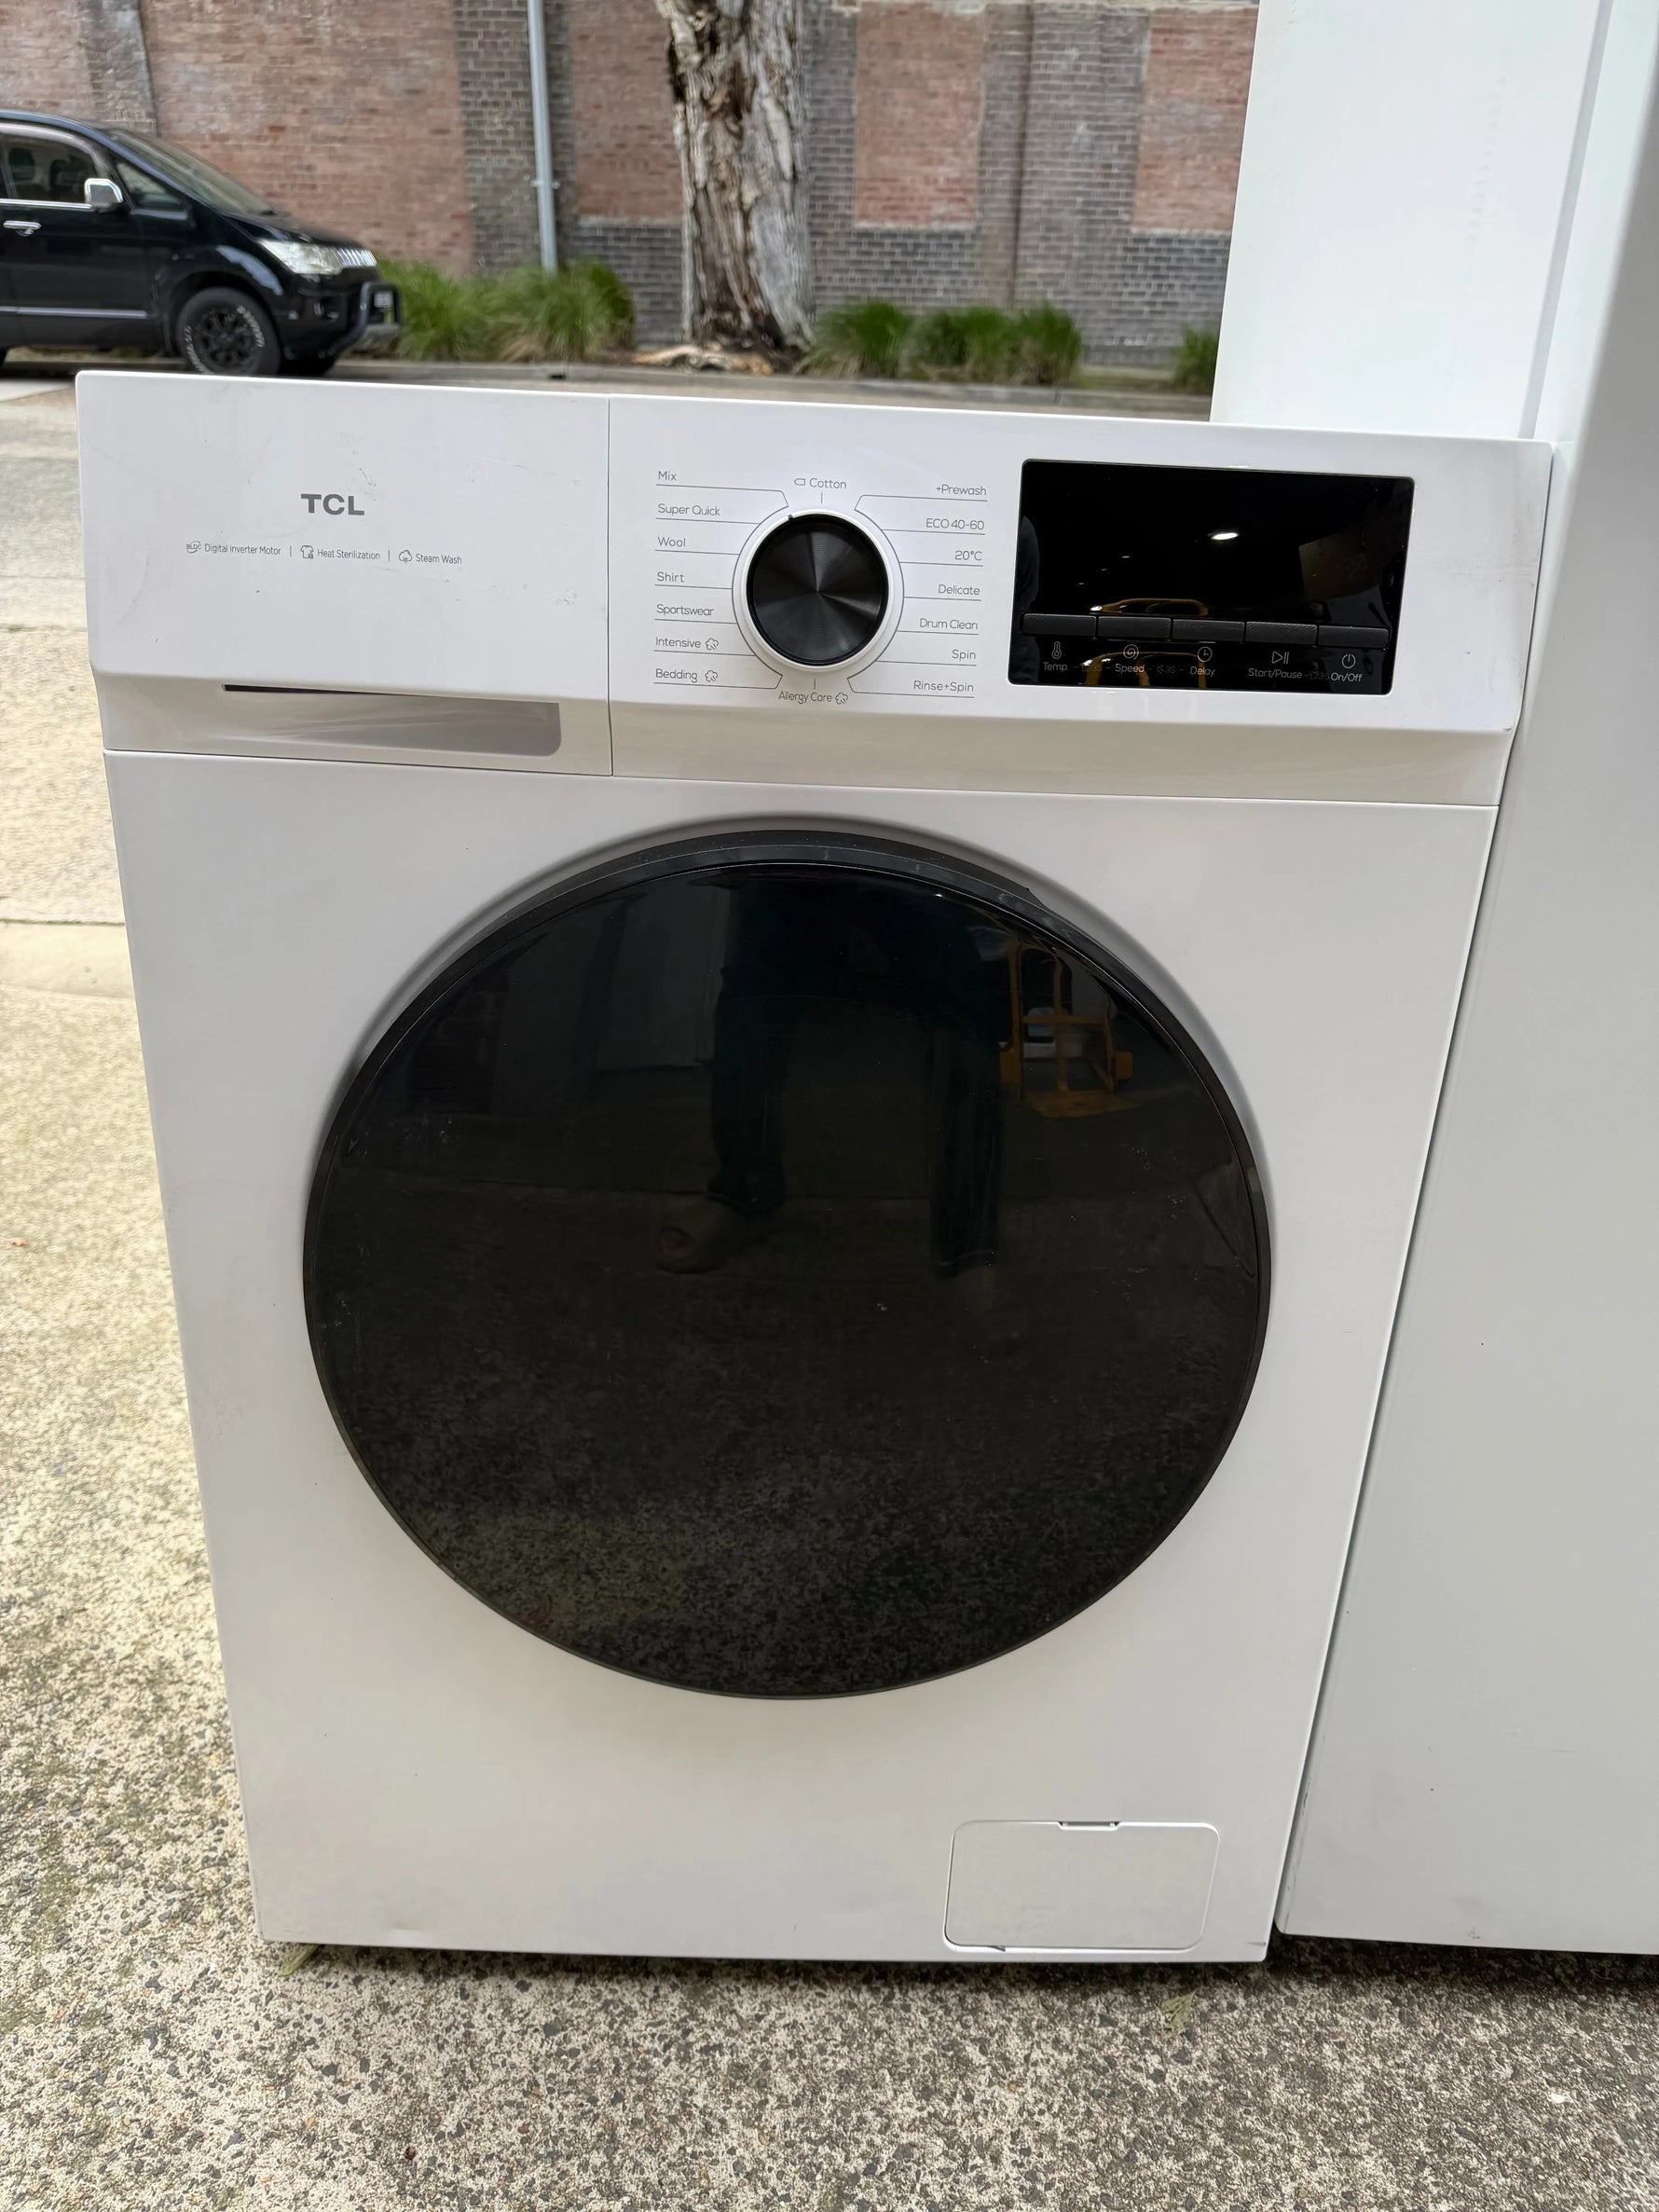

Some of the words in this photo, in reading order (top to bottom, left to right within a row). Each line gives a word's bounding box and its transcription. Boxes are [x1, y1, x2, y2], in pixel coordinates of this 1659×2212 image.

[658, 470, 677, 481] Mix
[809, 477, 847, 489] Cotton
[935, 484, 987, 496] +Prewash
[300, 493, 365, 516] TCL
[657, 503, 692, 517] Super
[692, 504, 720, 516] Quick
[925, 517, 950, 529] ECO
[950, 519, 985, 530] 40-60
[657, 536, 686, 547] Wool
[204, 543, 228, 555] Digital
[229, 544, 258, 555] Inverter
[259, 545, 281, 556] Motor
[317, 548, 336, 558] Heat
[336, 549, 381, 560] Sterilization
[954, 550, 982, 561] 20°C
[416, 553, 440, 563] Steam
[441, 554, 462, 565] Wash
[656, 570, 685, 584] Shirt
[938, 584, 980, 596] Delicate
[656, 603, 715, 617] Sportswear
[919, 617, 948, 629] Drum
[949, 619, 979, 630] Clean
[655, 637, 702, 649] Intensive
[951, 649, 977, 662] Spin
[655, 667, 698, 682] Bedding
[1114, 662, 1145, 676] Speed
[1188, 664, 1216, 678] Delay
[1247, 667, 1303, 680] Start/Pause
[1330, 671, 1364, 682] On/Off
[912, 680, 975, 694] Rinse+Spin
[778, 691, 810, 705] Allergy
[810, 692, 832, 703] Care
